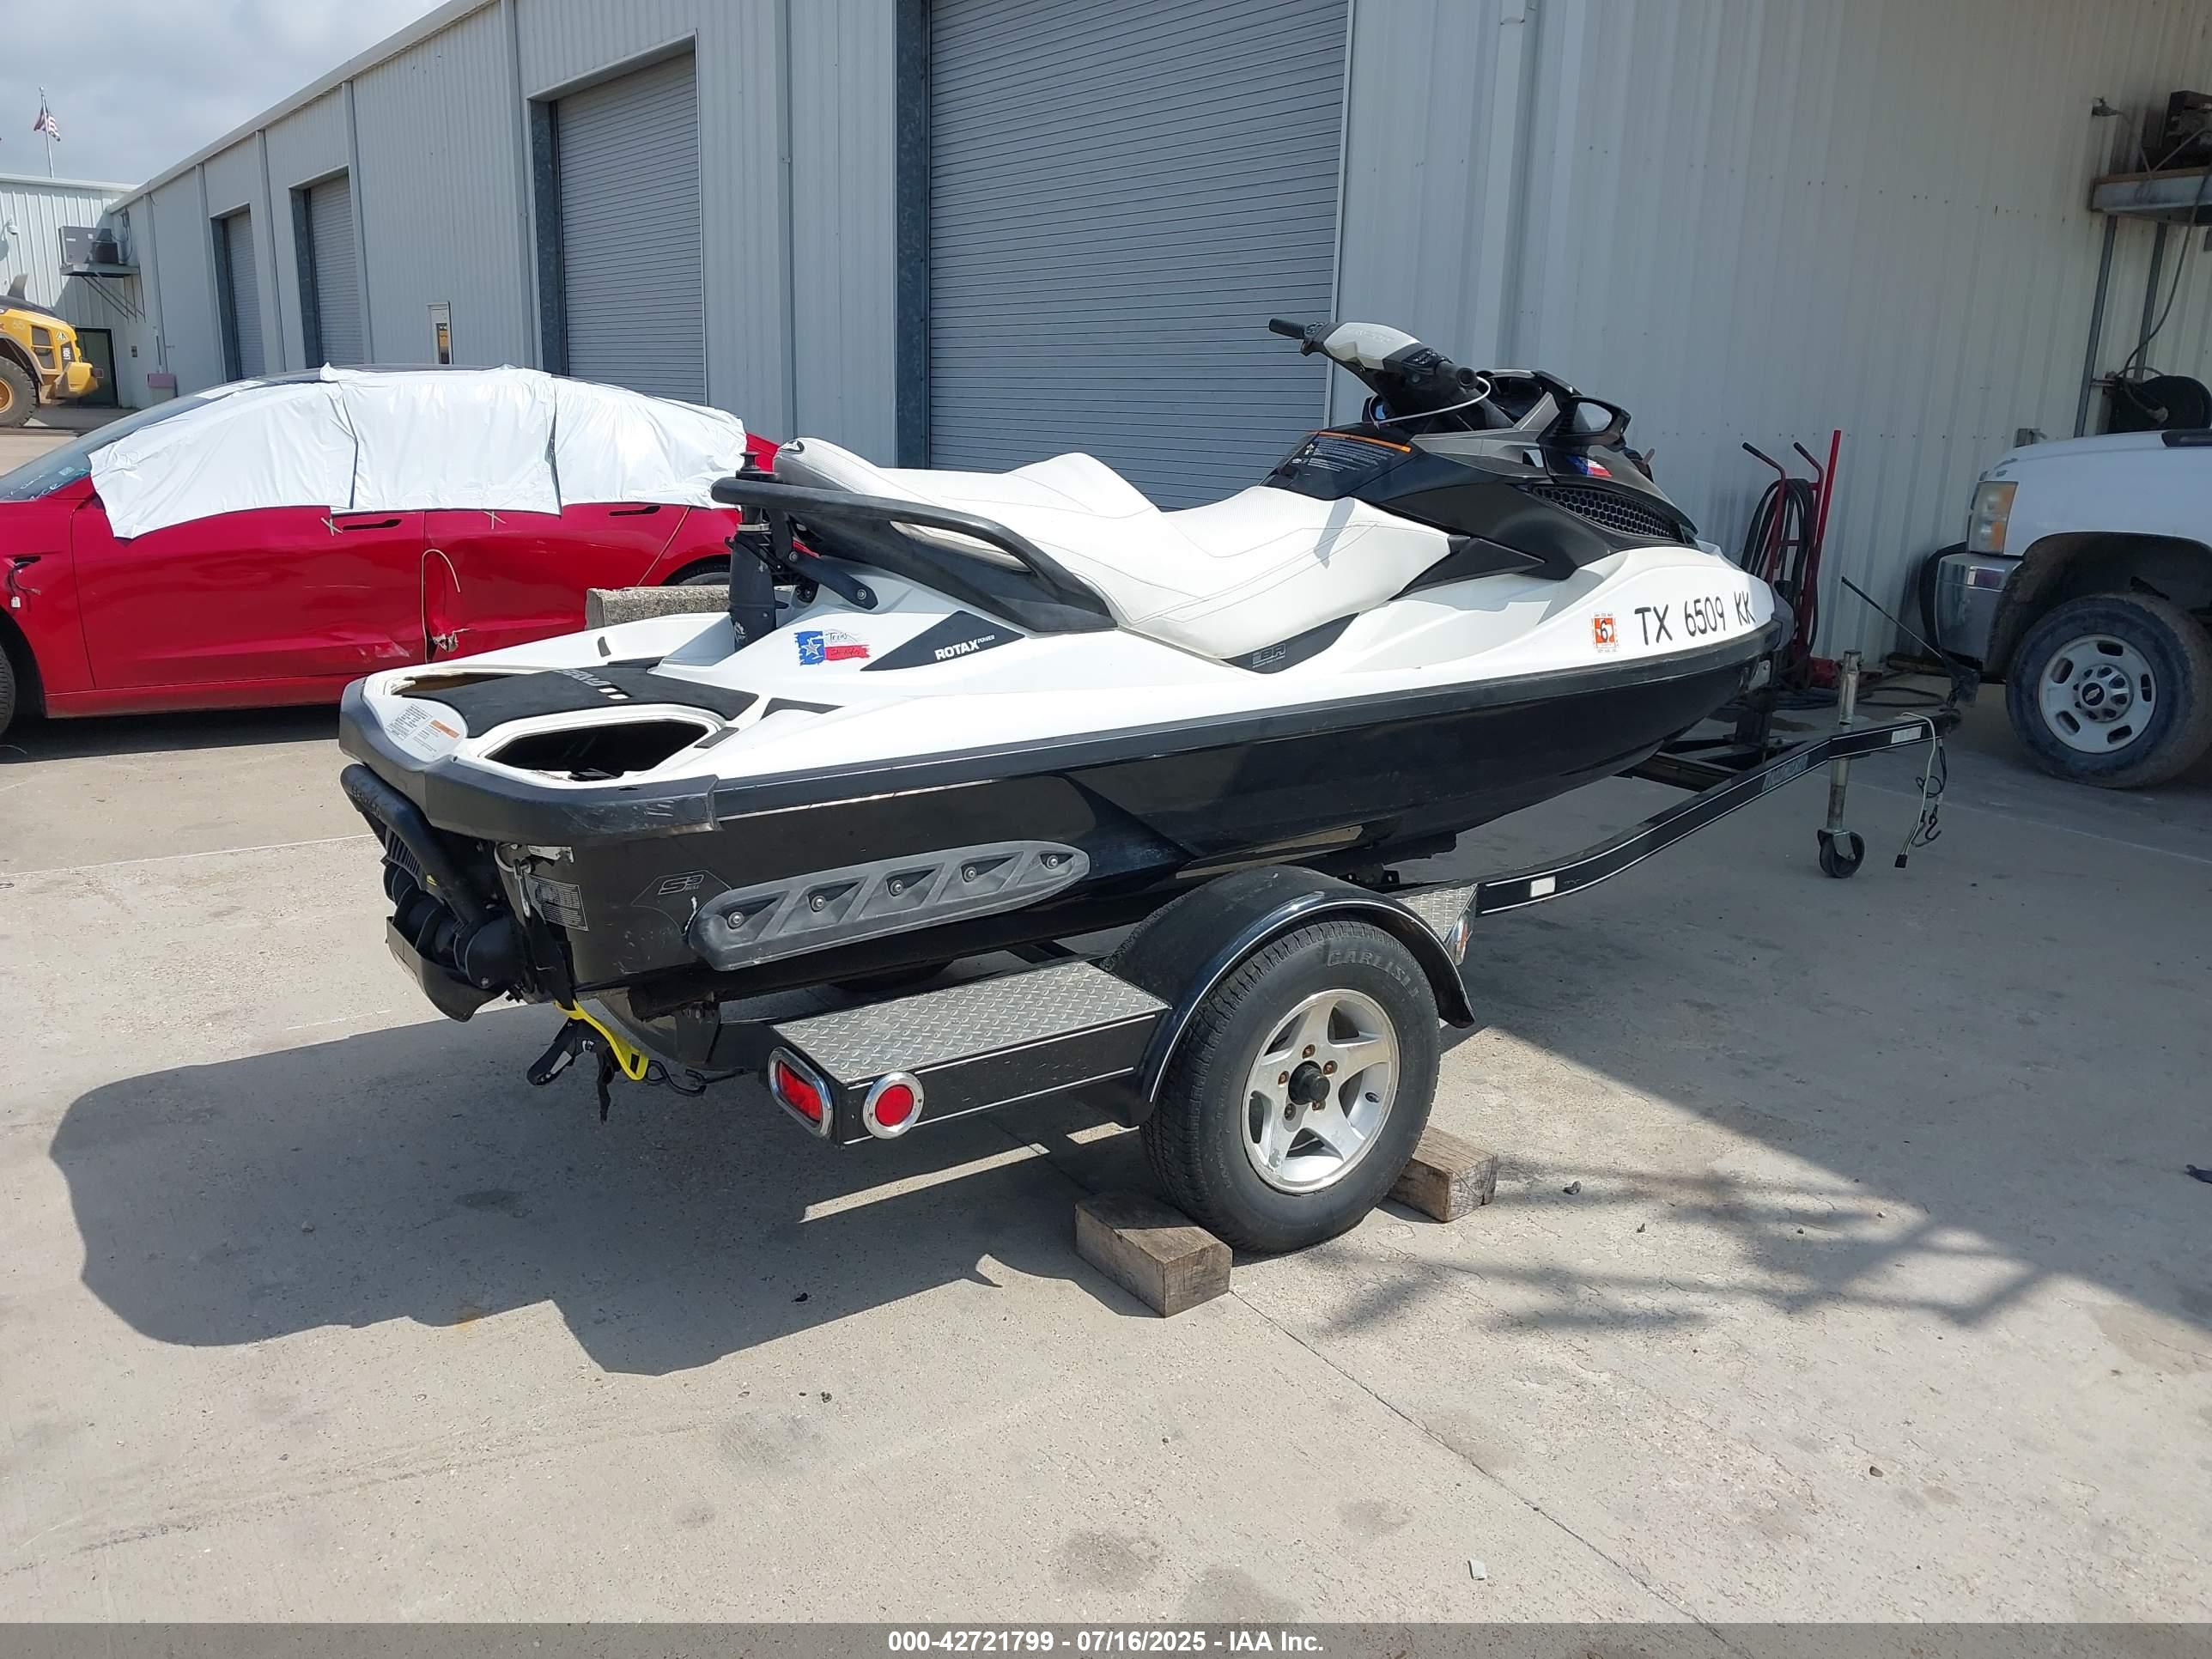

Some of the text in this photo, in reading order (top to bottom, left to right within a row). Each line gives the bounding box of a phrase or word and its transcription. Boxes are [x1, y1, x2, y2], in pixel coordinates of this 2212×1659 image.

[1634, 590, 1757, 646] TX 6509 KK
[934, 639, 980, 660] ROTAX
